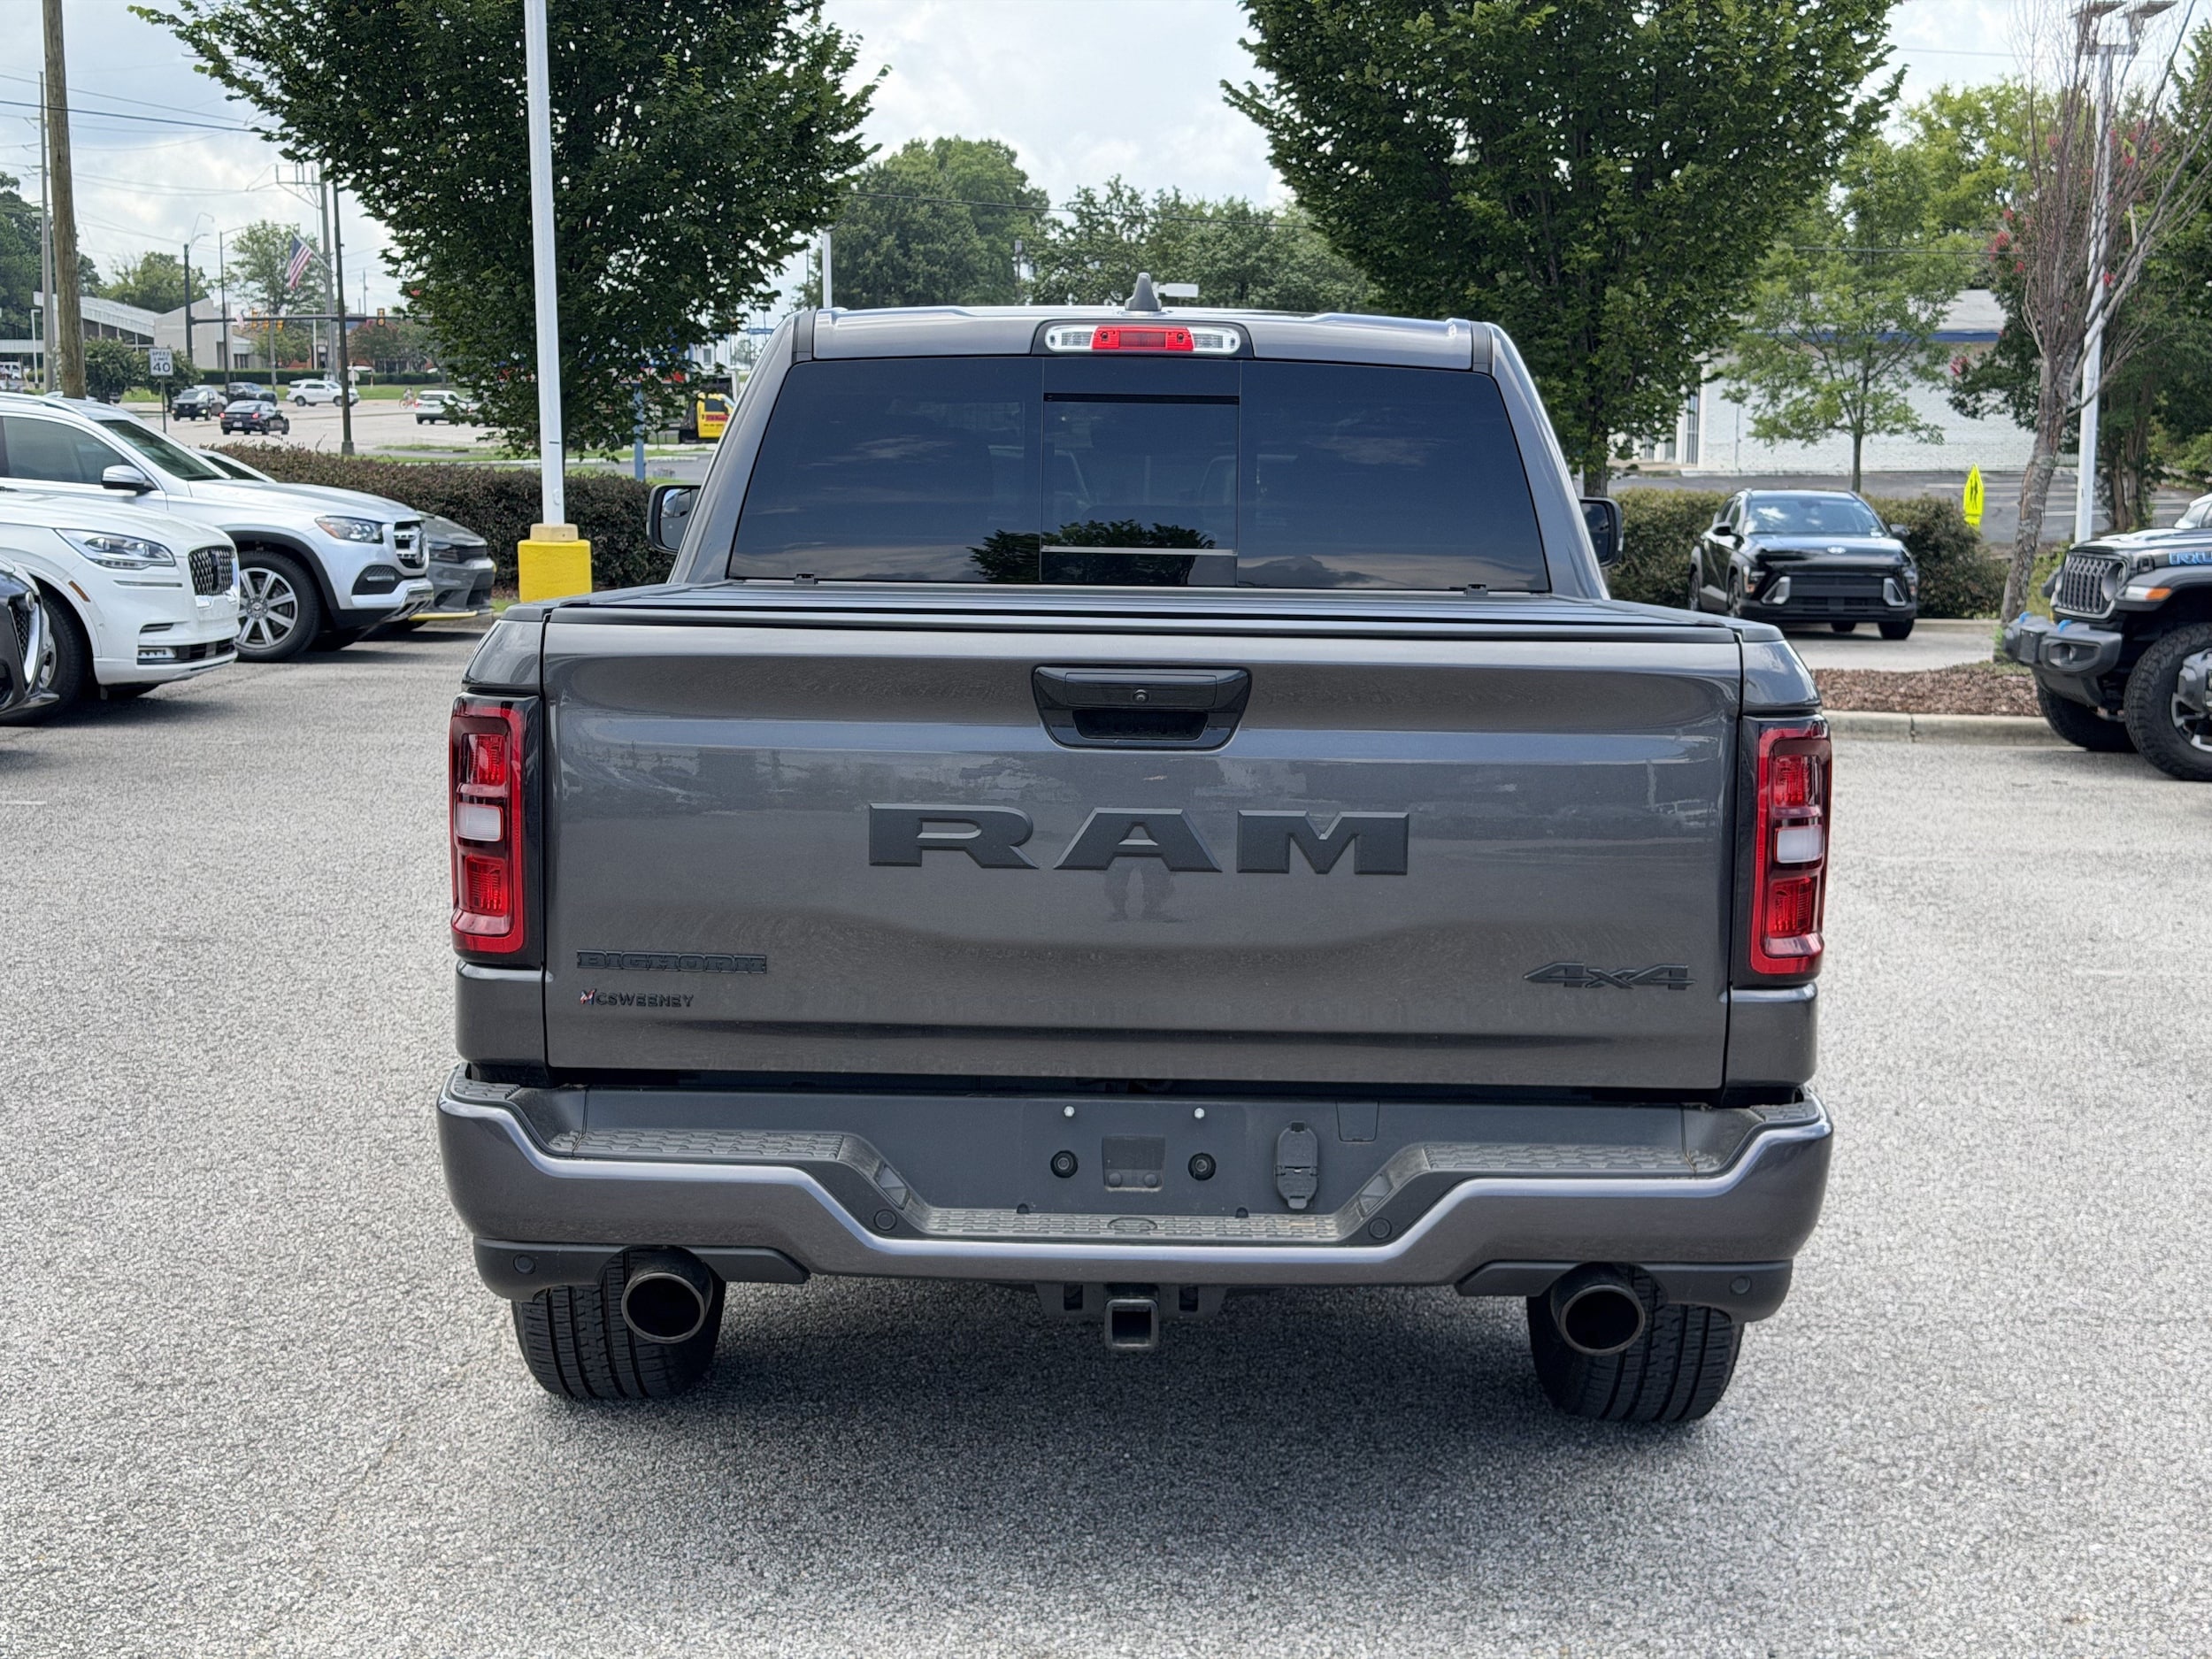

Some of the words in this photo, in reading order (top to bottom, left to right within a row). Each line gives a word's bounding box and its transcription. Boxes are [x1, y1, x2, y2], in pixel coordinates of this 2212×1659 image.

[153, 362, 171, 373] 40
[869, 803, 1409, 875] RAM
[1524, 962, 1698, 990] 4x4
